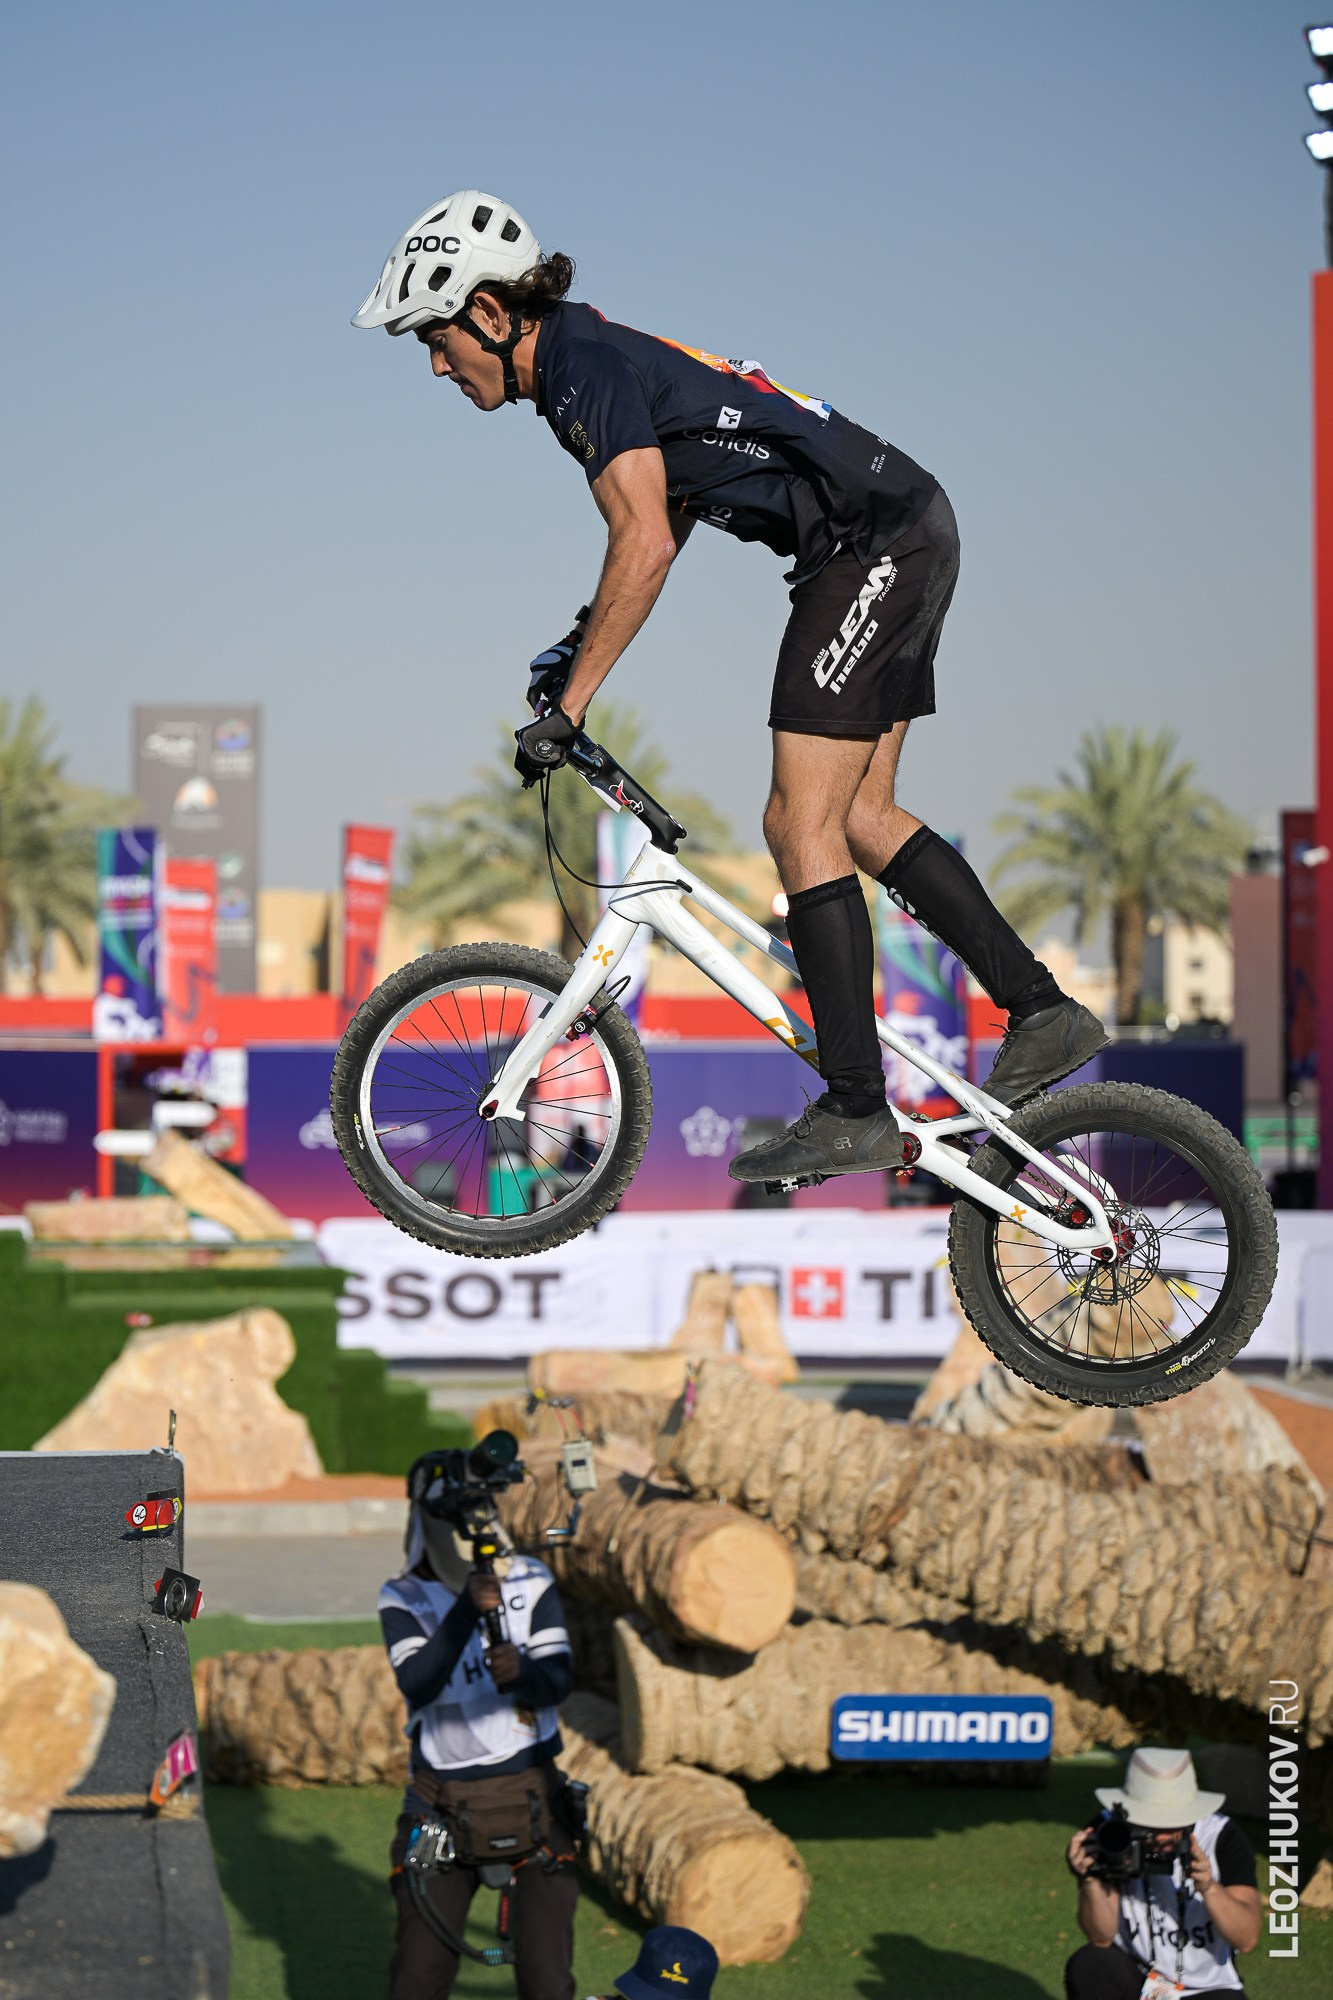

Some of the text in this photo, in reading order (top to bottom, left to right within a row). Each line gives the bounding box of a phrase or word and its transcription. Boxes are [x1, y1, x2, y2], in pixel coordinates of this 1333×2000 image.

[878, 566, 899, 602] FACTORY
[814, 556, 893, 689] CLEAN
[811, 648, 829, 669] TEAM
[838, 1711, 1050, 1743] SHIMANO
